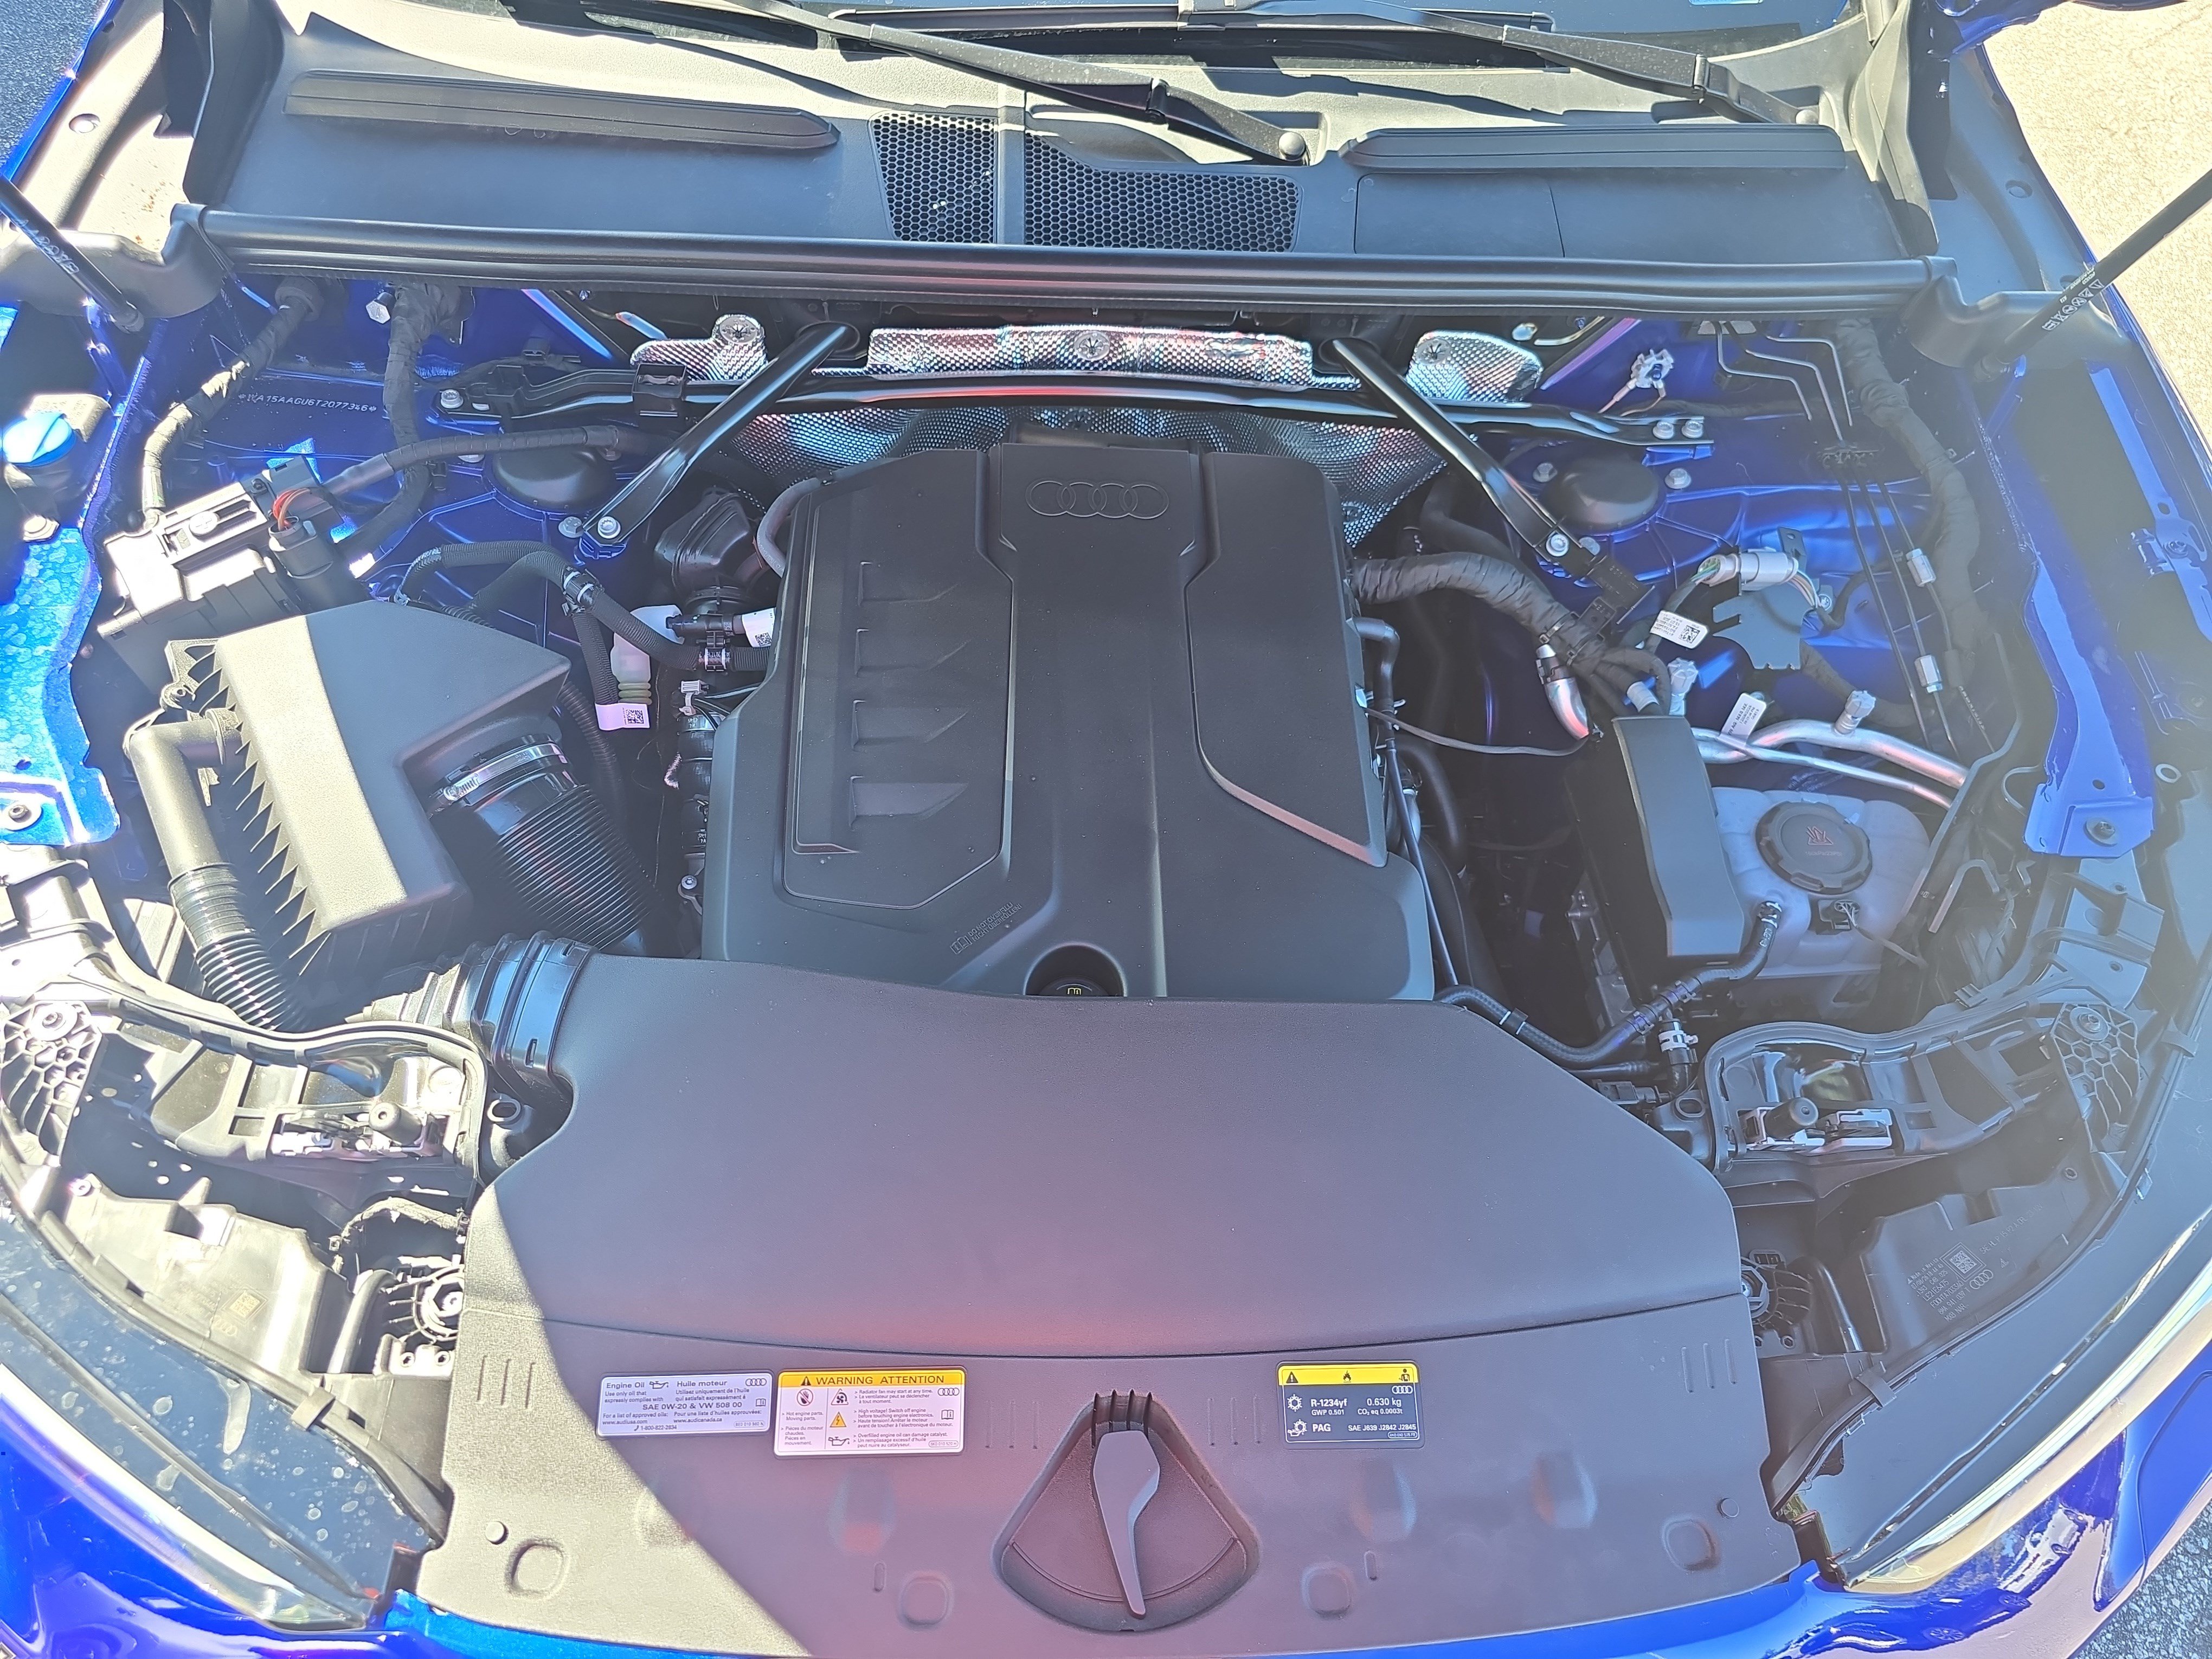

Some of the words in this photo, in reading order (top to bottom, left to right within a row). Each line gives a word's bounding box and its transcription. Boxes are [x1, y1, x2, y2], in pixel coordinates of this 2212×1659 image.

[968, 928, 978, 936] DO
[976, 919, 988, 931] NOT
[816, 1377, 873, 1385] WARNING
[880, 1375, 944, 1384] ATTENTION
[1310, 1398, 1347, 1408] R-1234yf
[1367, 1398, 1389, 1406] 0.630
[1391, 1397, 1401, 1407] kg
[1312, 1423, 1331, 1432] PAG
